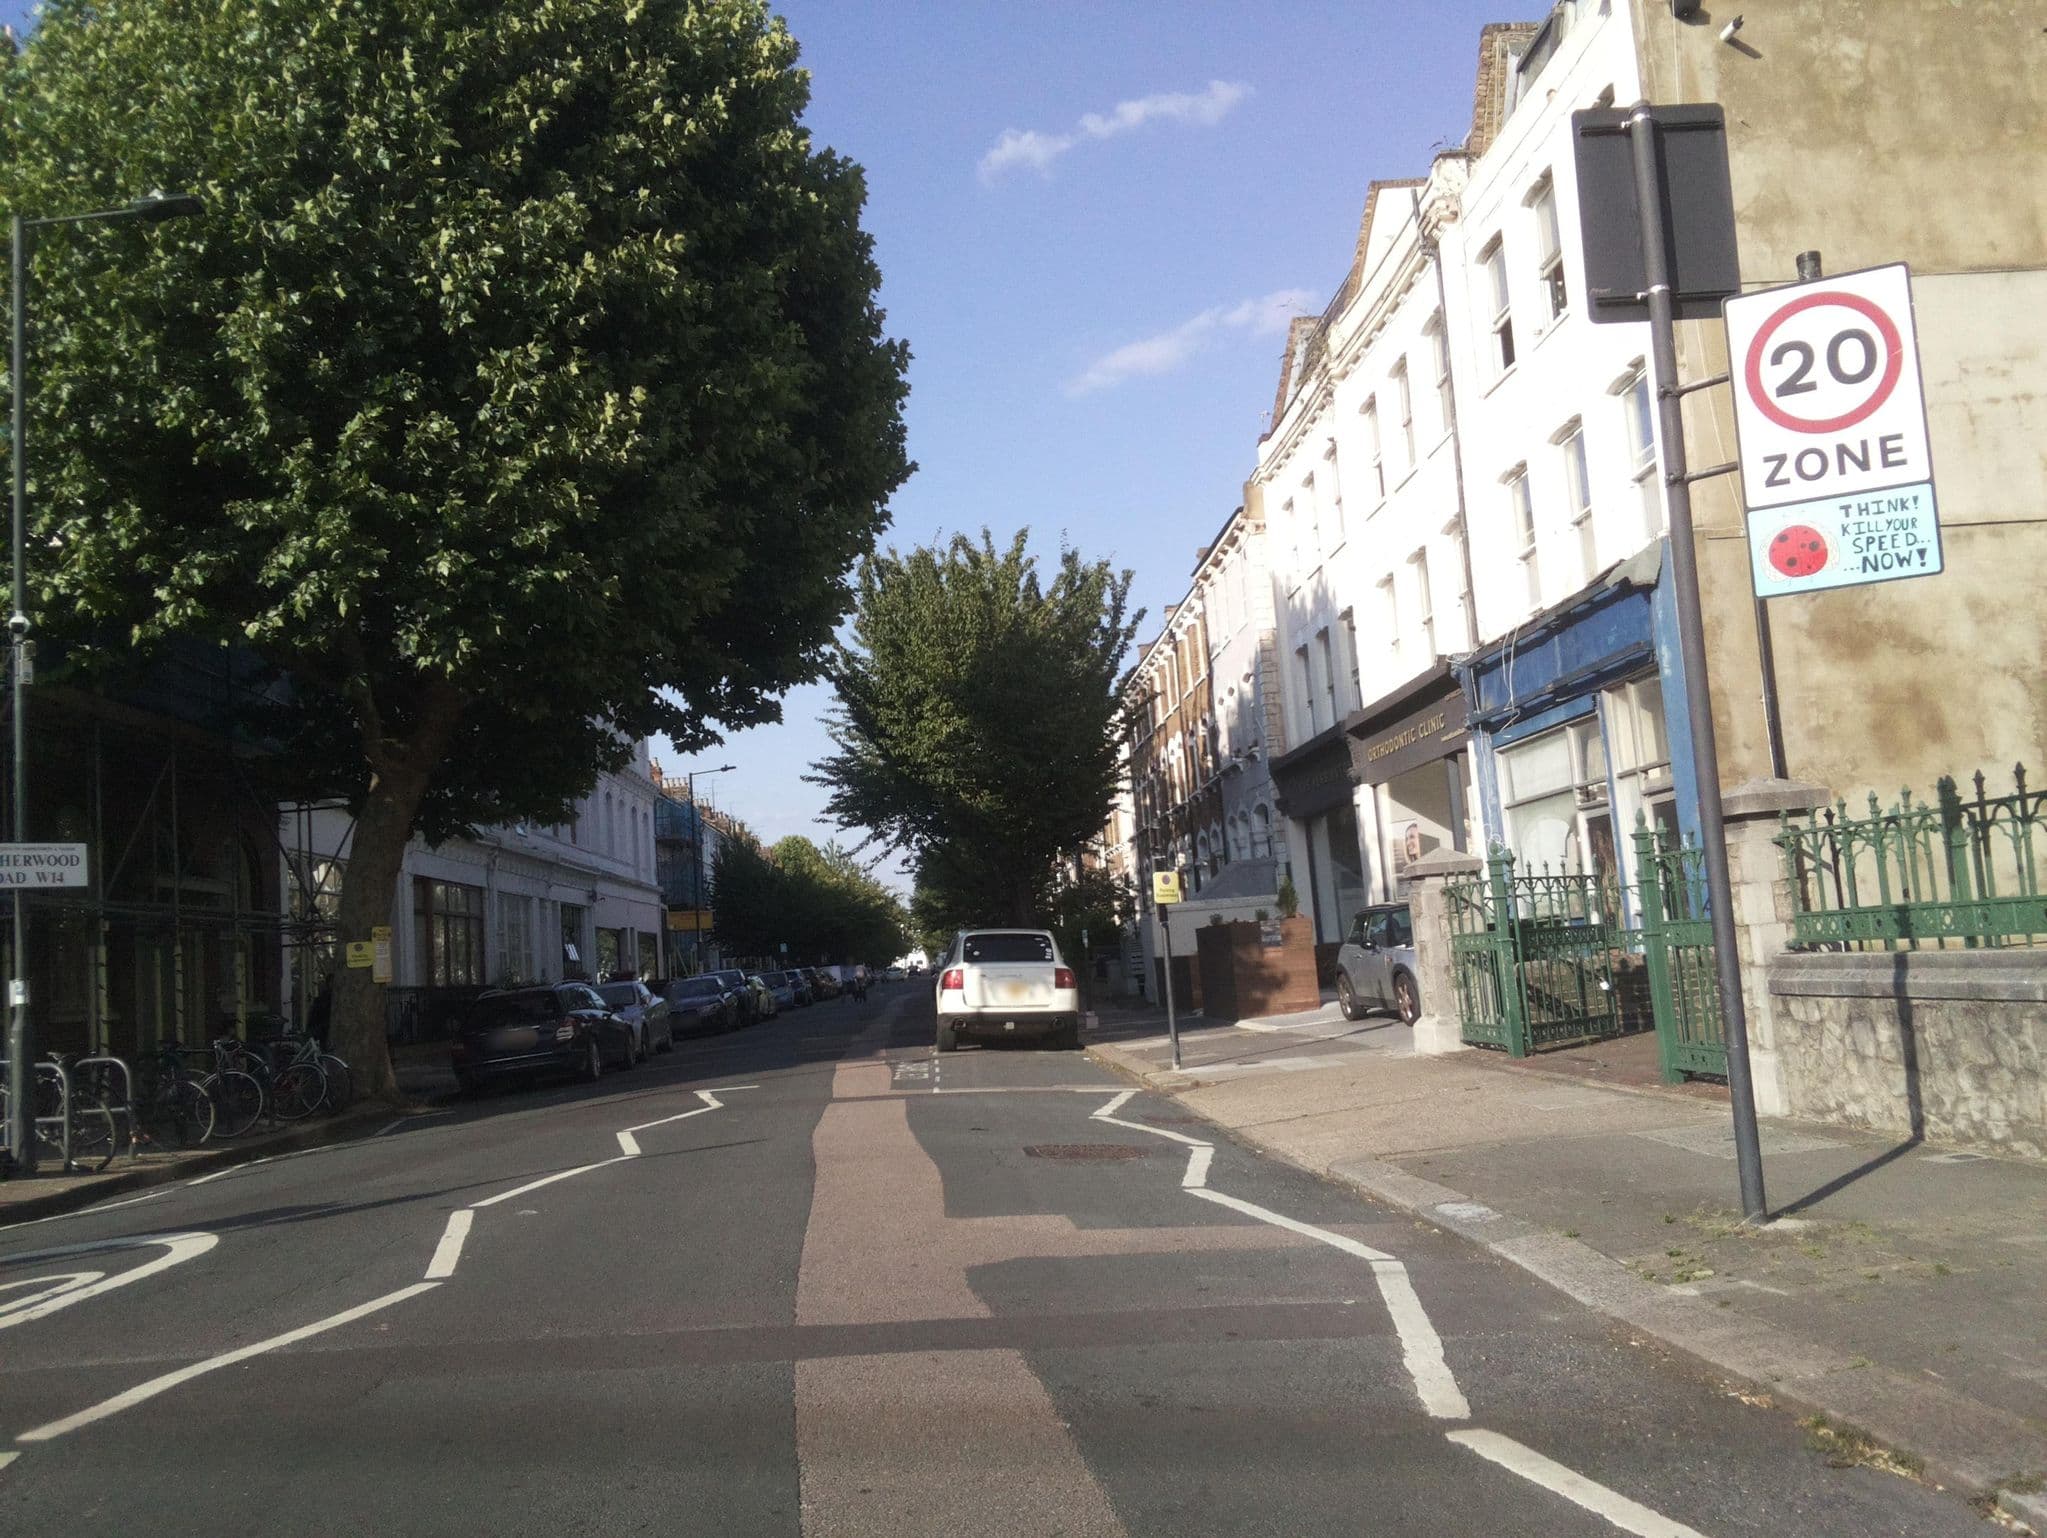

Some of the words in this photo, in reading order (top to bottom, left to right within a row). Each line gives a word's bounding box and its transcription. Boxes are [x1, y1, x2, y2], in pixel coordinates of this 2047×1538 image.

[1770, 328, 1877, 398] 20
[1762, 433, 1907, 488] ZONE
[1839, 495, 1919, 518] THINK!
[1367, 728, 1416, 762] ORTHODONTIC
[1418, 713, 1446, 738] CLINIC
[35, 871, 65, 884] W14
